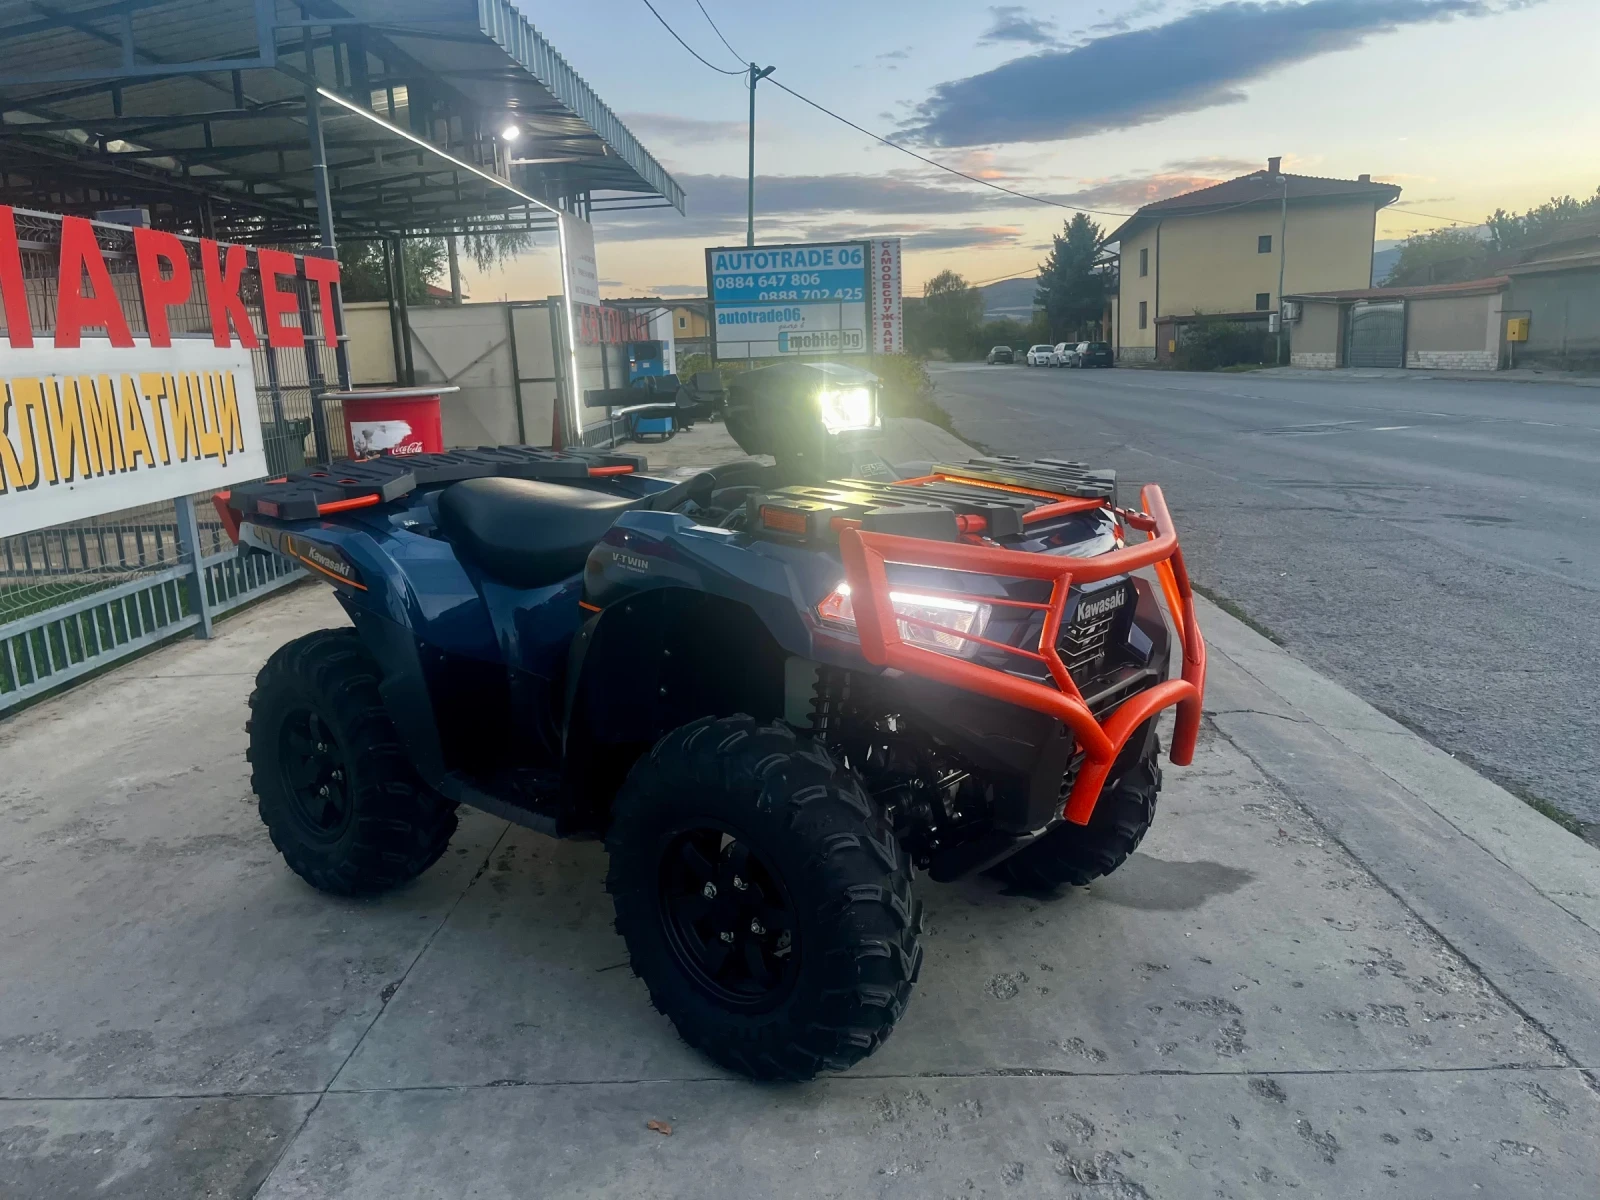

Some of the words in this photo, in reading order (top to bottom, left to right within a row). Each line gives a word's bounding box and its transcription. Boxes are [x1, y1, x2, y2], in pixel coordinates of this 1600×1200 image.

[715, 250, 834, 271] AUTOTRADE
[838, 248, 862, 265] 06
[715, 275, 754, 289] 0884
[758, 274, 786, 288] 647
[790, 273, 821, 286] 806
[834, 287, 863, 300] 425
[790, 331, 860, 348] mobilebg
[308, 546, 351, 577] Kawasaki
[1077, 588, 1125, 622] Kawasaki
